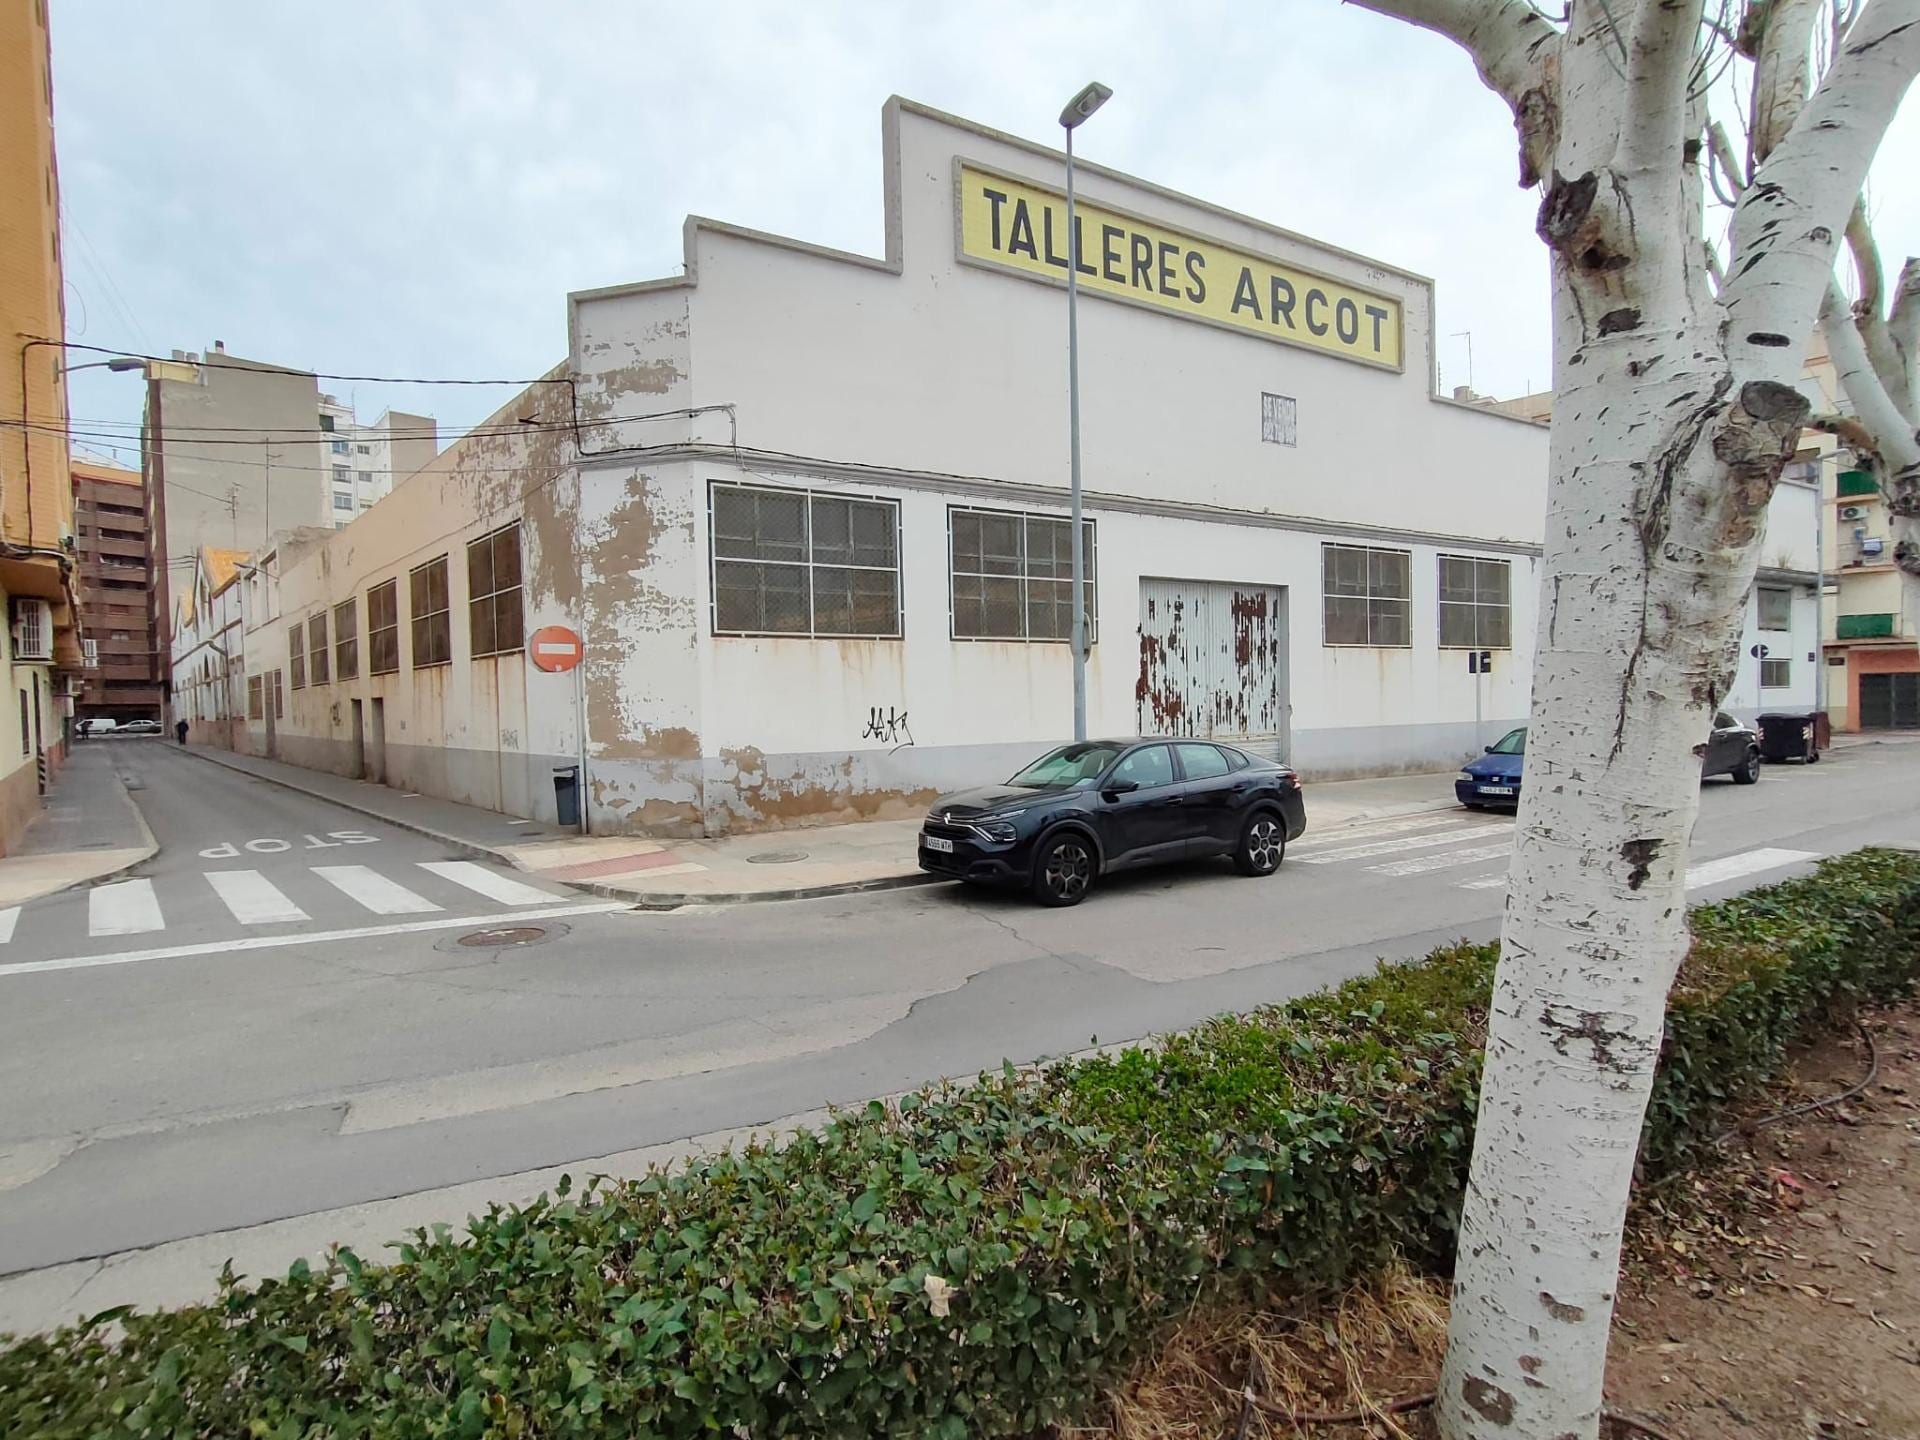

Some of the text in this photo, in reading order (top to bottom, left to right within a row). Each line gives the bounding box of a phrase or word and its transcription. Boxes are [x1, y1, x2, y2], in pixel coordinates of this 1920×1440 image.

[983, 188, 1388, 353] TALLERES ARCOT
[198, 831, 381, 858] STOP
